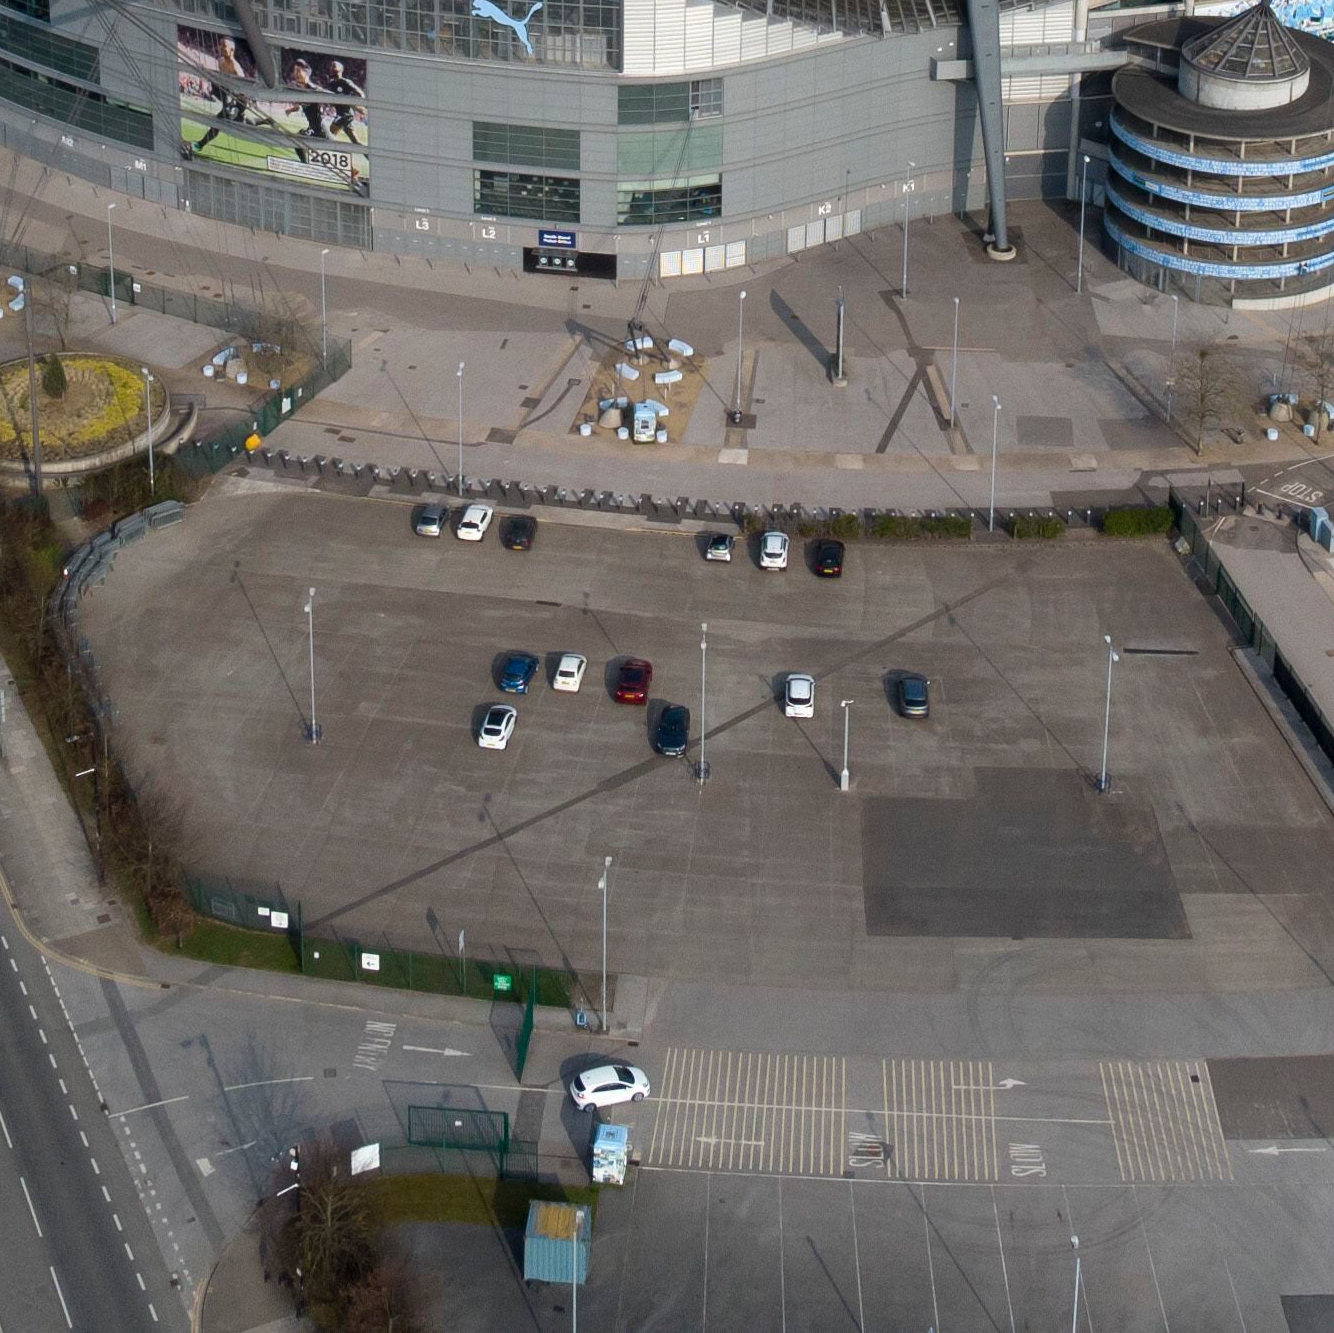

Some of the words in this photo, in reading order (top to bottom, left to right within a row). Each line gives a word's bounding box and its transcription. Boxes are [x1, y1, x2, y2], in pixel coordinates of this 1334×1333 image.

[310, 149, 349, 168] 2018
[818, 204, 832, 216] K2
[415, 220, 429, 231] L3
[482, 228, 496, 239] L2
[697, 233, 710, 244] L1
[1280, 481, 1324, 503] STOP
[363, 1020, 397, 1037] NO
[848, 1131, 885, 1168] SLOW
[1008, 1142, 1047, 1178] SLOW
